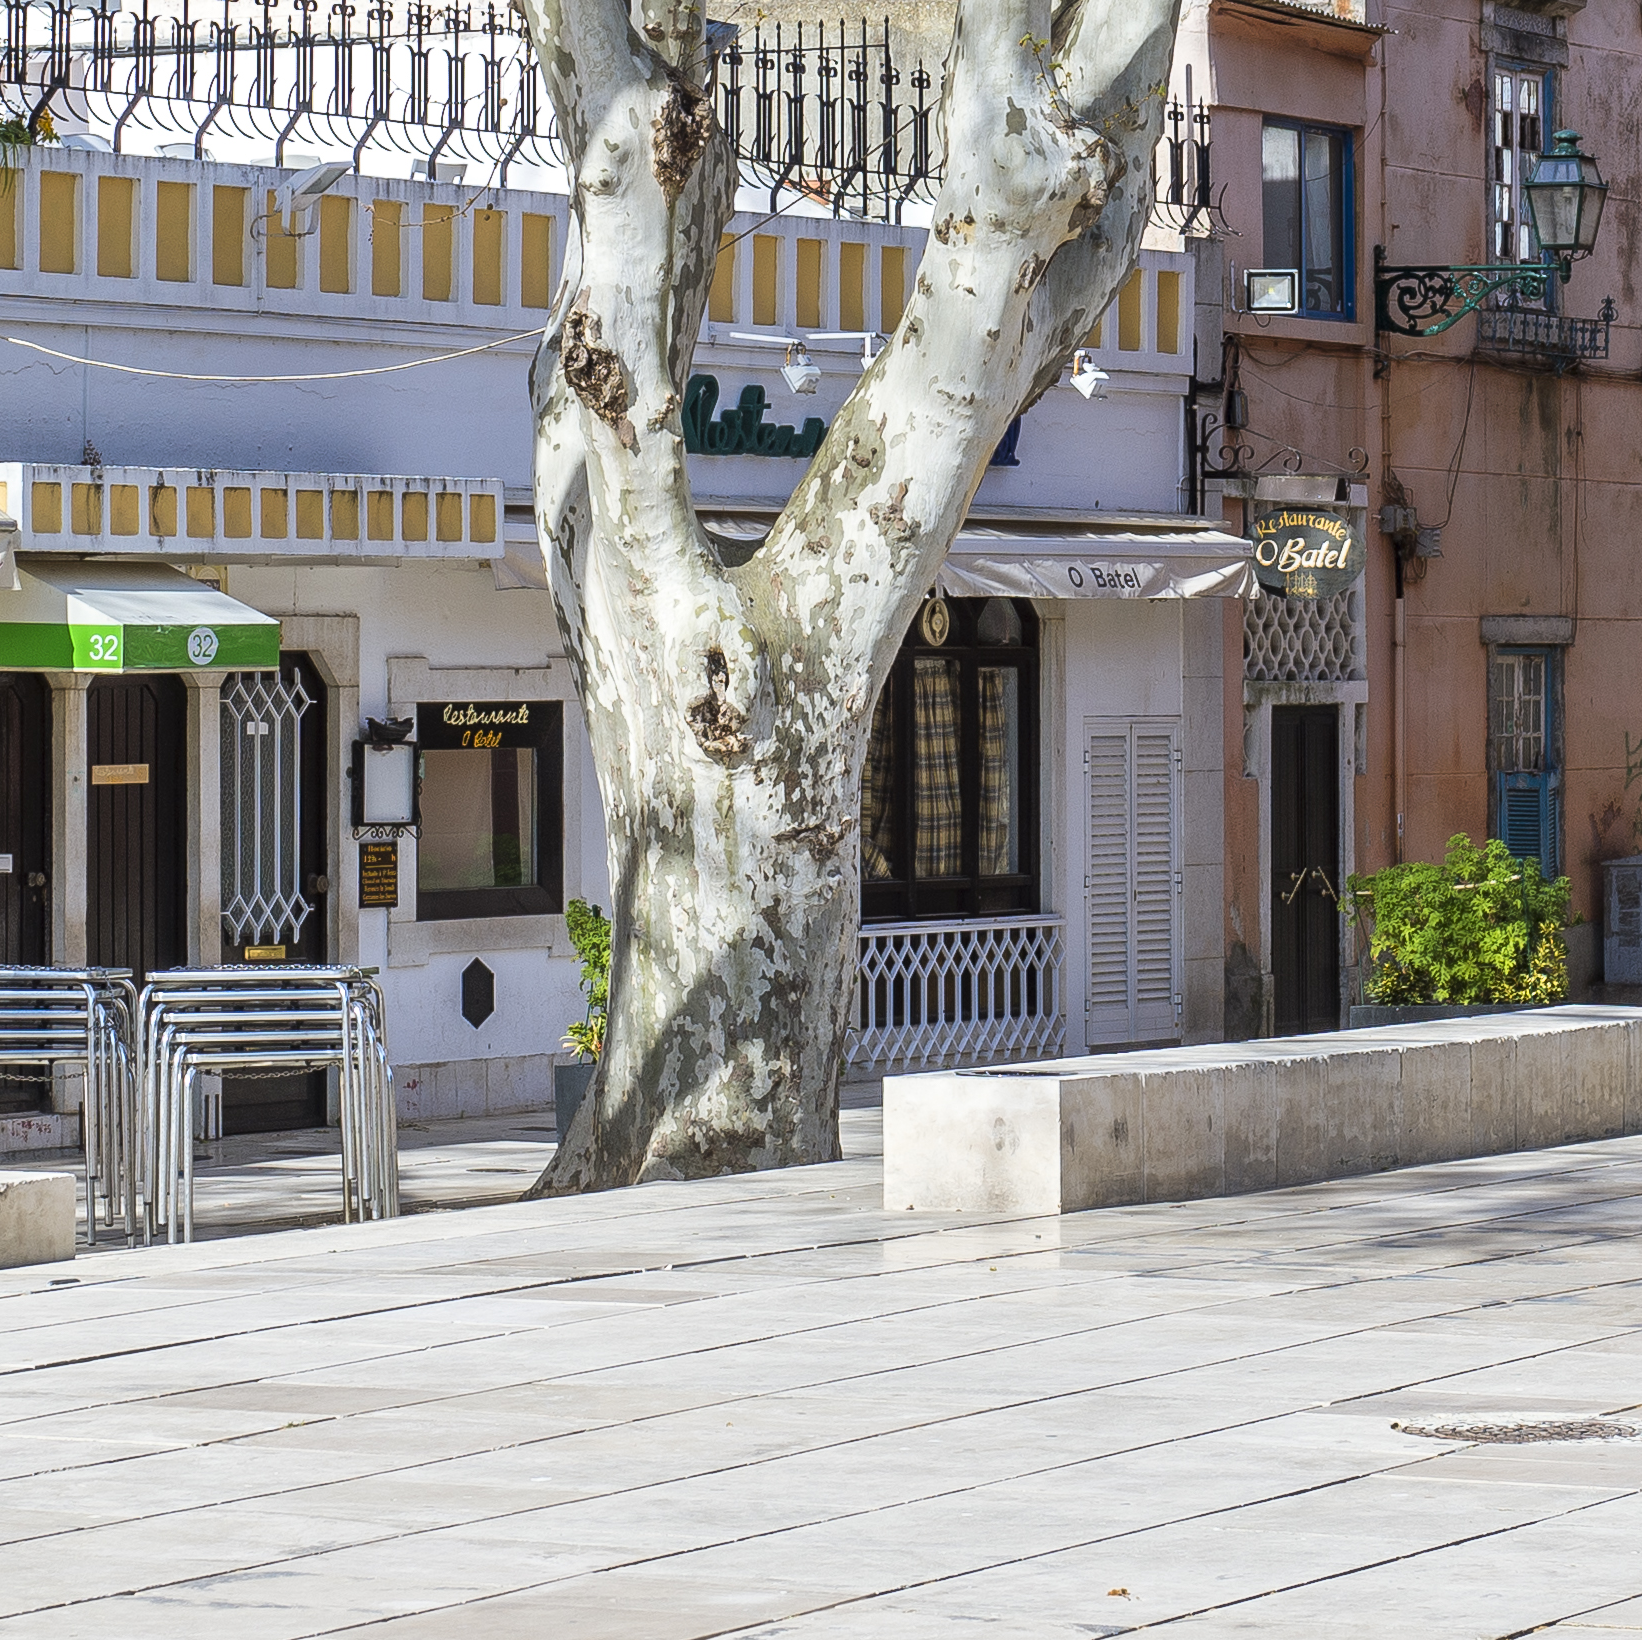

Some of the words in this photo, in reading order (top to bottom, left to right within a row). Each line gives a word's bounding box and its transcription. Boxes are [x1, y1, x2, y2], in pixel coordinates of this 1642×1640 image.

[1256, 511, 1347, 540] Restaurante
[1256, 540, 1278, 567] O
[1278, 537, 1352, 573] Batel
[1067, 566, 1084, 589] O
[1090, 567, 1142, 589] Batel
[89, 634, 119, 661] 32
[192, 634, 214, 658] 32
[443, 703, 529, 725] Restaurante
